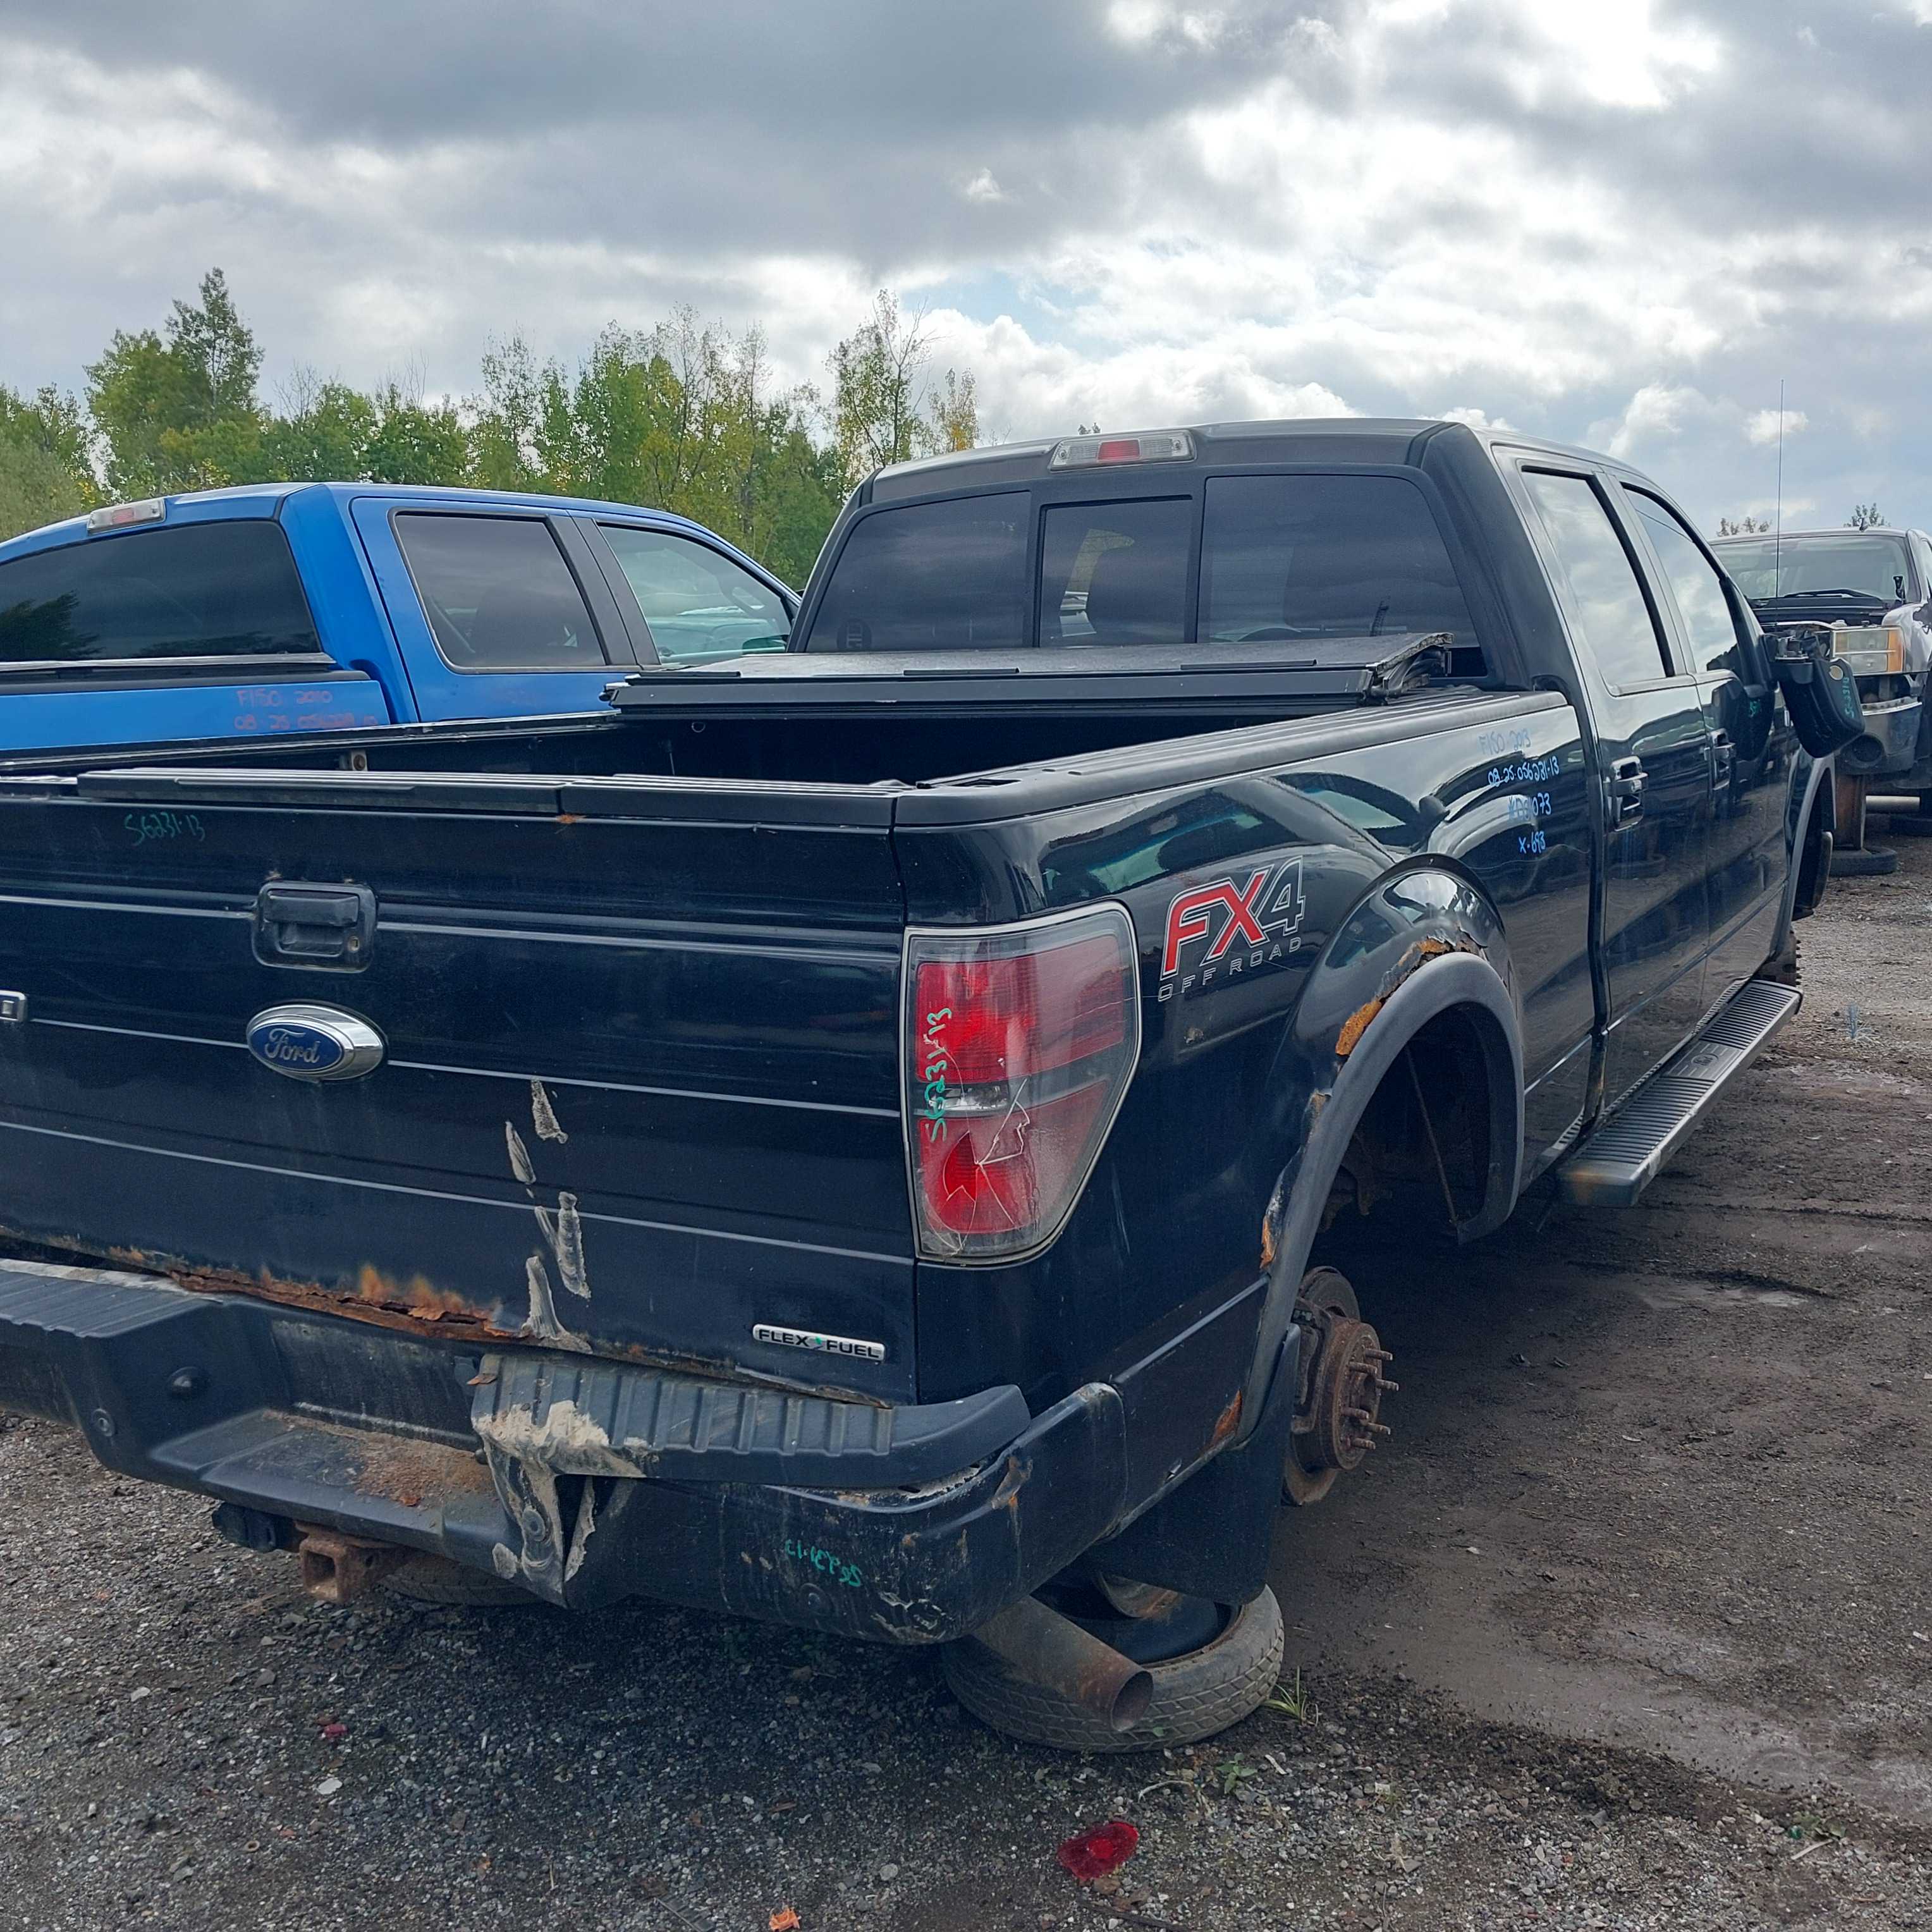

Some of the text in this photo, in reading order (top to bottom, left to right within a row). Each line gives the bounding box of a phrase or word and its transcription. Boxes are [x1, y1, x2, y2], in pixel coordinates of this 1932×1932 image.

[1478, 728, 1532, 755] F150 2013
[1159, 855, 1306, 981] FX4
[1158, 937, 1301, 1002] OFF ROAD
[264, 1028, 321, 1063] Ford
[759, 1329, 879, 1358] FLEX FUEL
